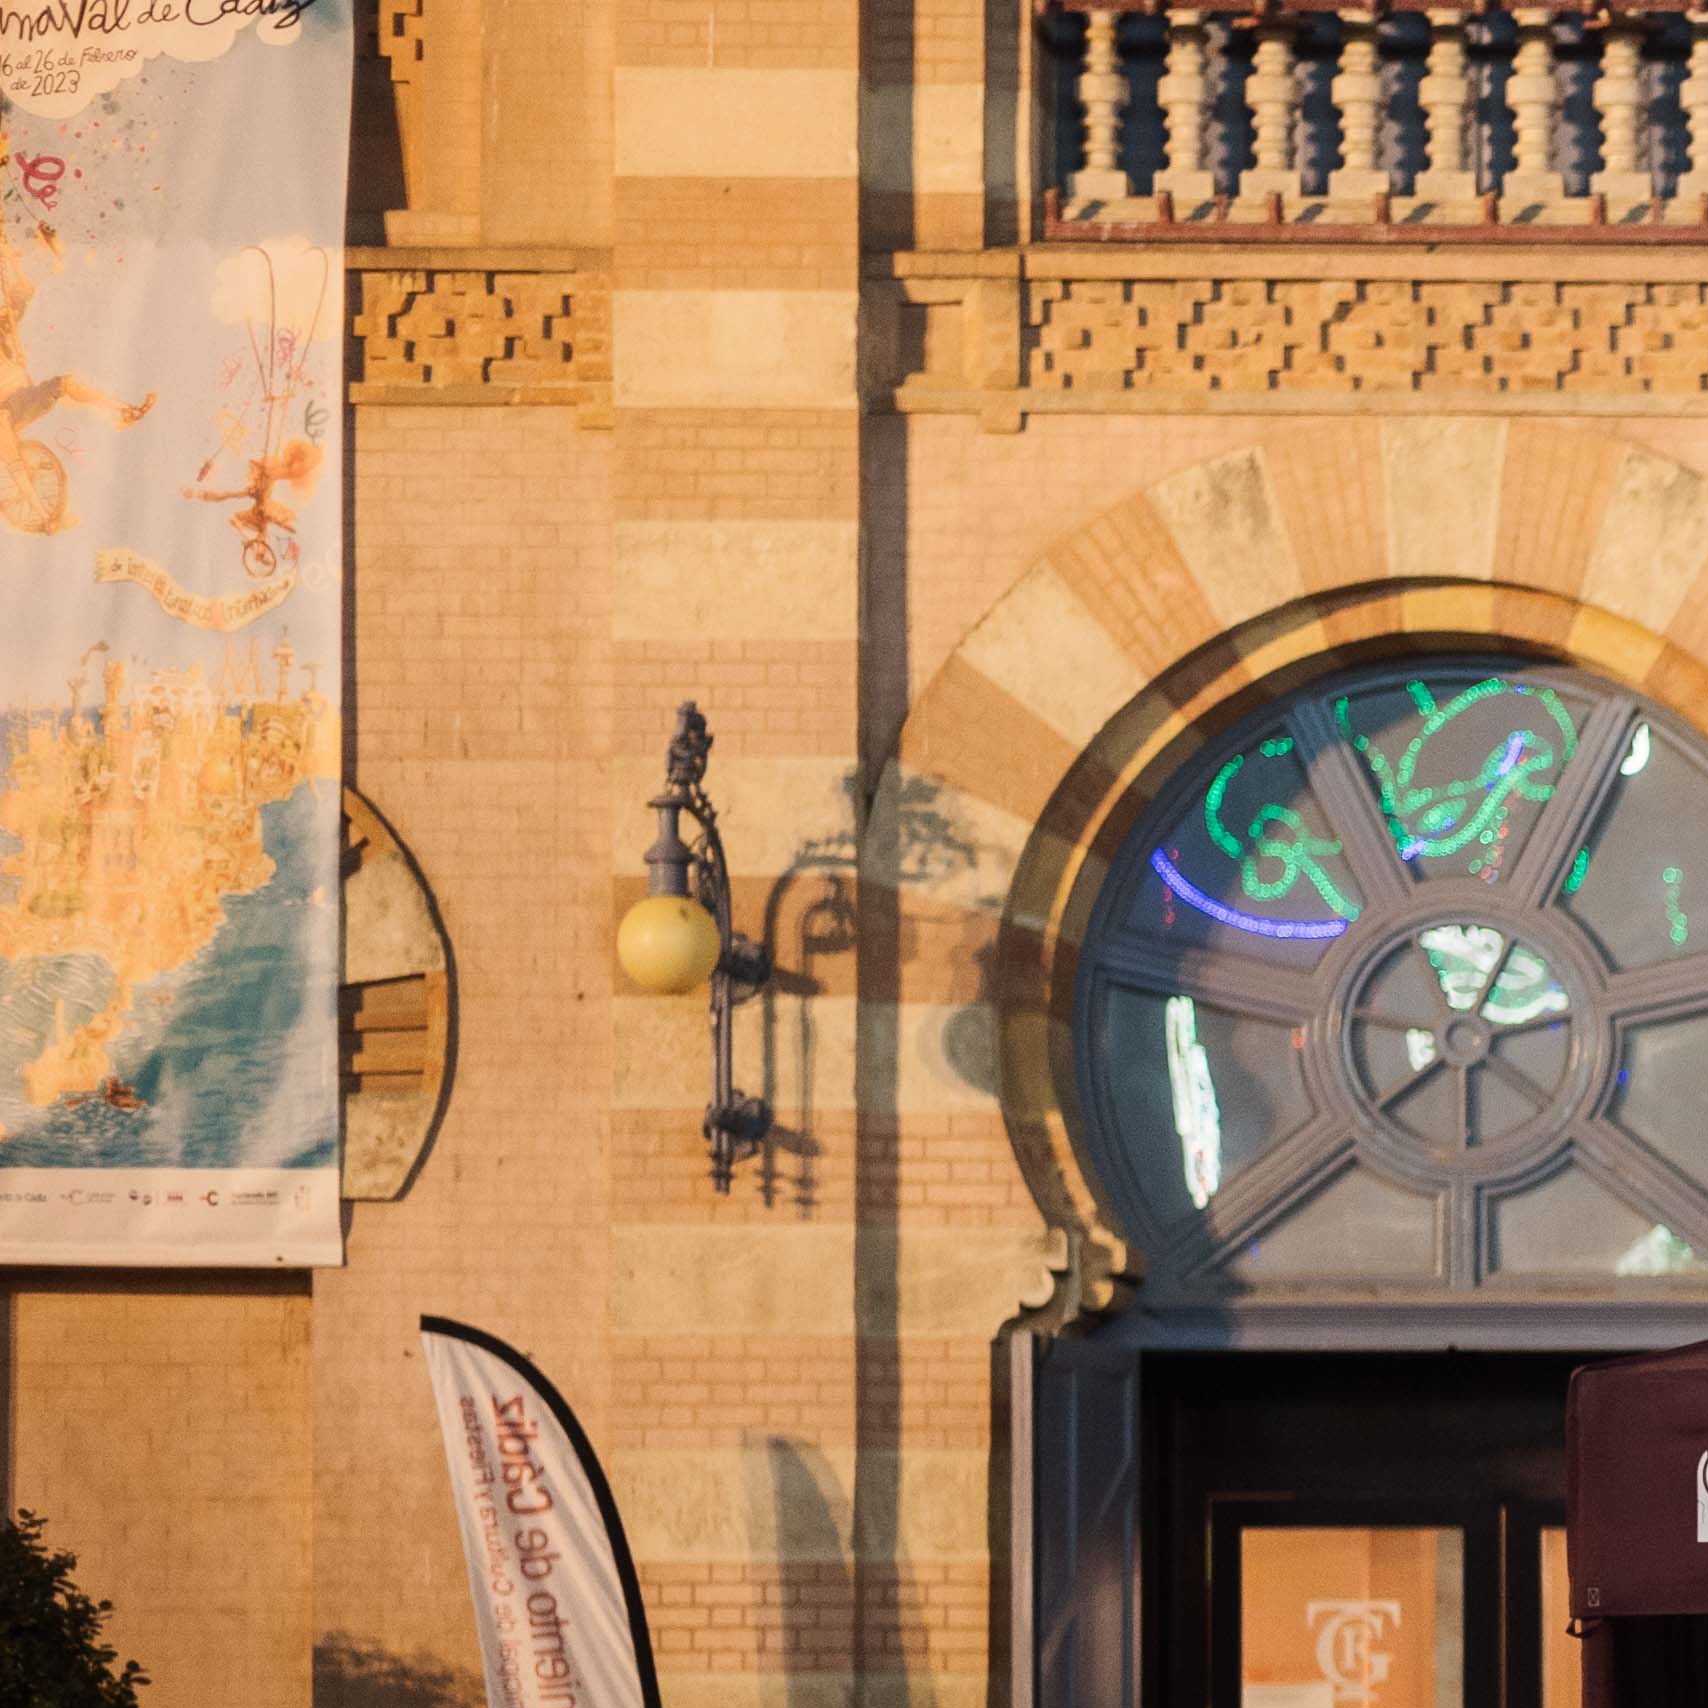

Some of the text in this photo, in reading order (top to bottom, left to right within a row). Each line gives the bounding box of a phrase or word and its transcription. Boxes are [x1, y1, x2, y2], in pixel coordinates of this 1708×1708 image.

[137, 0, 180, 25] de
[16, 54, 32, 70] al
[33, 48, 55, 74] 26
[57, 51, 76, 66] de
[80, 46, 138, 67] Febrero
[31, 69, 81, 97] 2023
